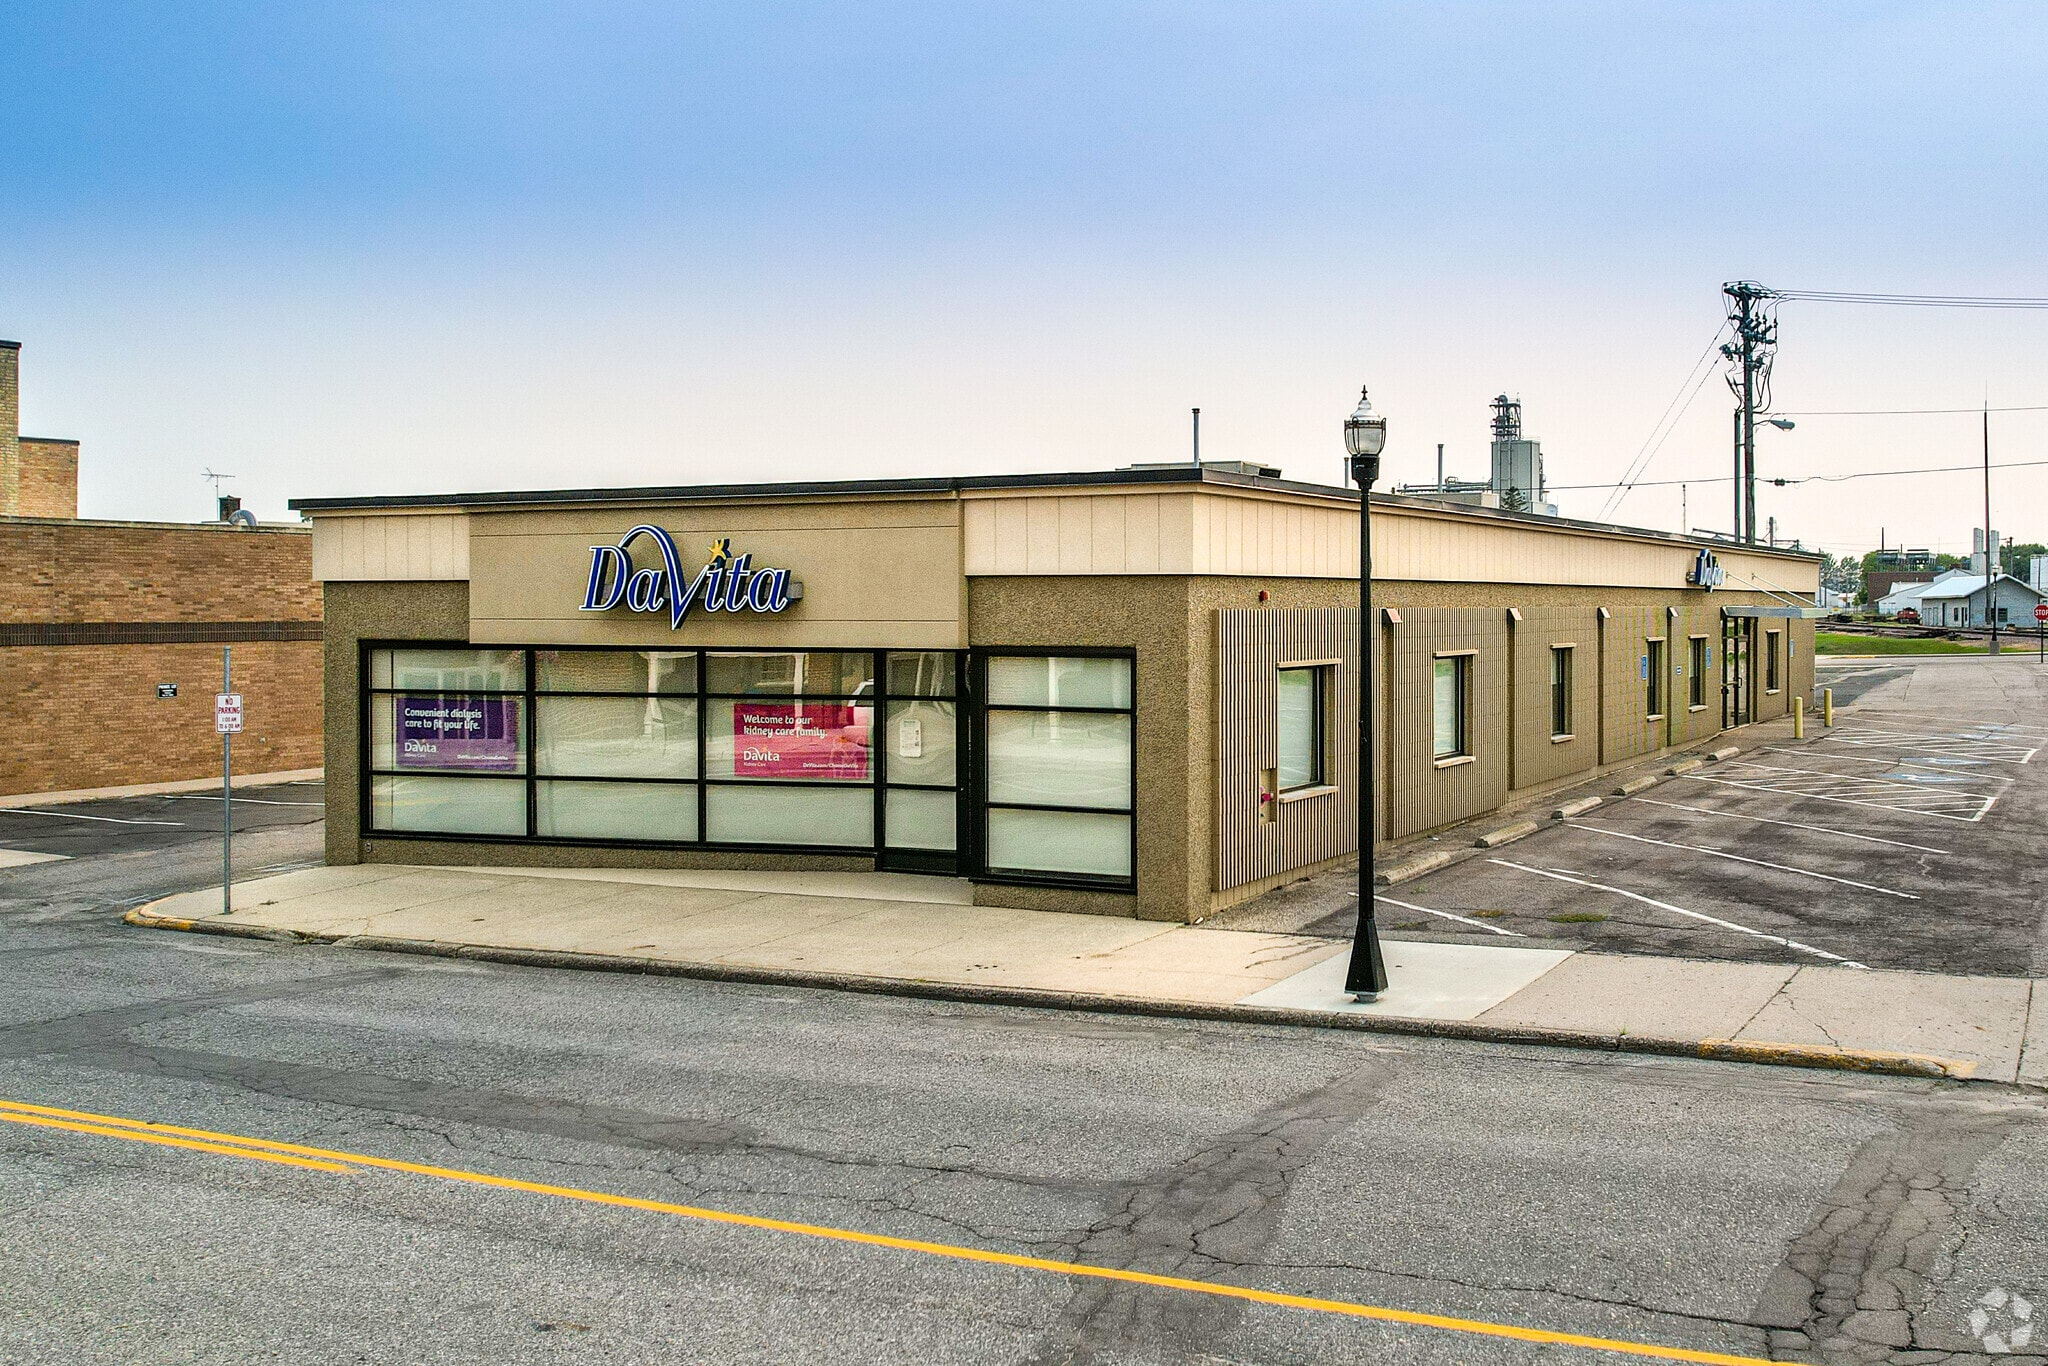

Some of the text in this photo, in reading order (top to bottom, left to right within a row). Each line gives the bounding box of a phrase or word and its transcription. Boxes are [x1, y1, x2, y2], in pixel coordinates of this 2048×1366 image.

[578, 524, 792, 631] DaVita
[218, 706, 240, 714] PARKING
[404, 707, 482, 721] Convenient dialysis
[404, 719, 481, 732] care to fit your life.
[743, 714, 813, 726] Welcome to our
[743, 726, 829, 740] kidney care family.
[404, 738, 438, 754] DaVita
[743, 746, 781, 762] DaVita
